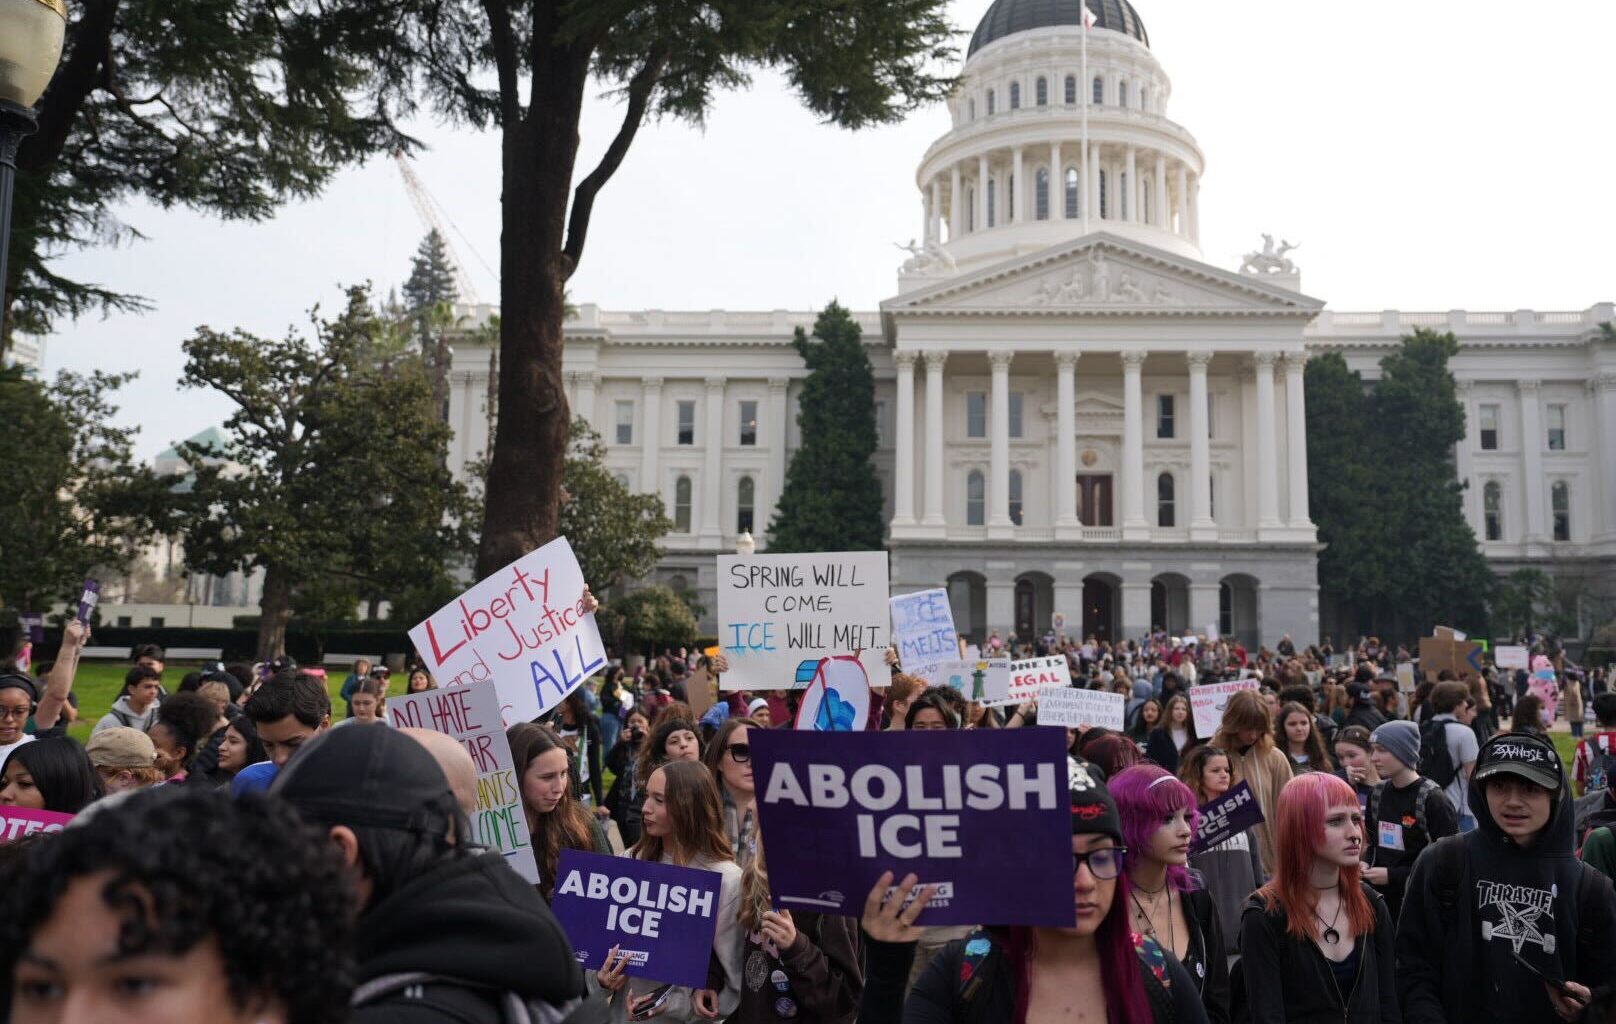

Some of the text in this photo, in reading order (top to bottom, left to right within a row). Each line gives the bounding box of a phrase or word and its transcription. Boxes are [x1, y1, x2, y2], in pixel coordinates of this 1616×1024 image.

[731, 563, 865, 589] SPRING WILL
[425, 566, 549, 667] Liberty
[765, 595, 833, 613] COME,
[498, 598, 586, 661] Justice
[725, 622, 777, 651] ICE
[786, 623, 826, 649] WILL
[902, 627, 957, 657] MELTS
[530, 634, 604, 709] ALL
[1009, 672, 1060, 688] EGAL
[1046, 659, 1064, 668] IS
[392, 700, 423, 729] NO
[427, 689, 483, 735] HATE
[458, 735, 499, 773] AR
[473, 770, 518, 813] ANTS
[763, 762, 1058, 811] ABOLISH
[1196, 788, 1251, 829] OLISH
[1197, 814, 1231, 840] ICE
[856, 813, 963, 859] ICE
[558, 869, 714, 918] ABOLISH
[1476, 879, 1555, 920] THRASHE
[606, 904, 662, 939] ICE
